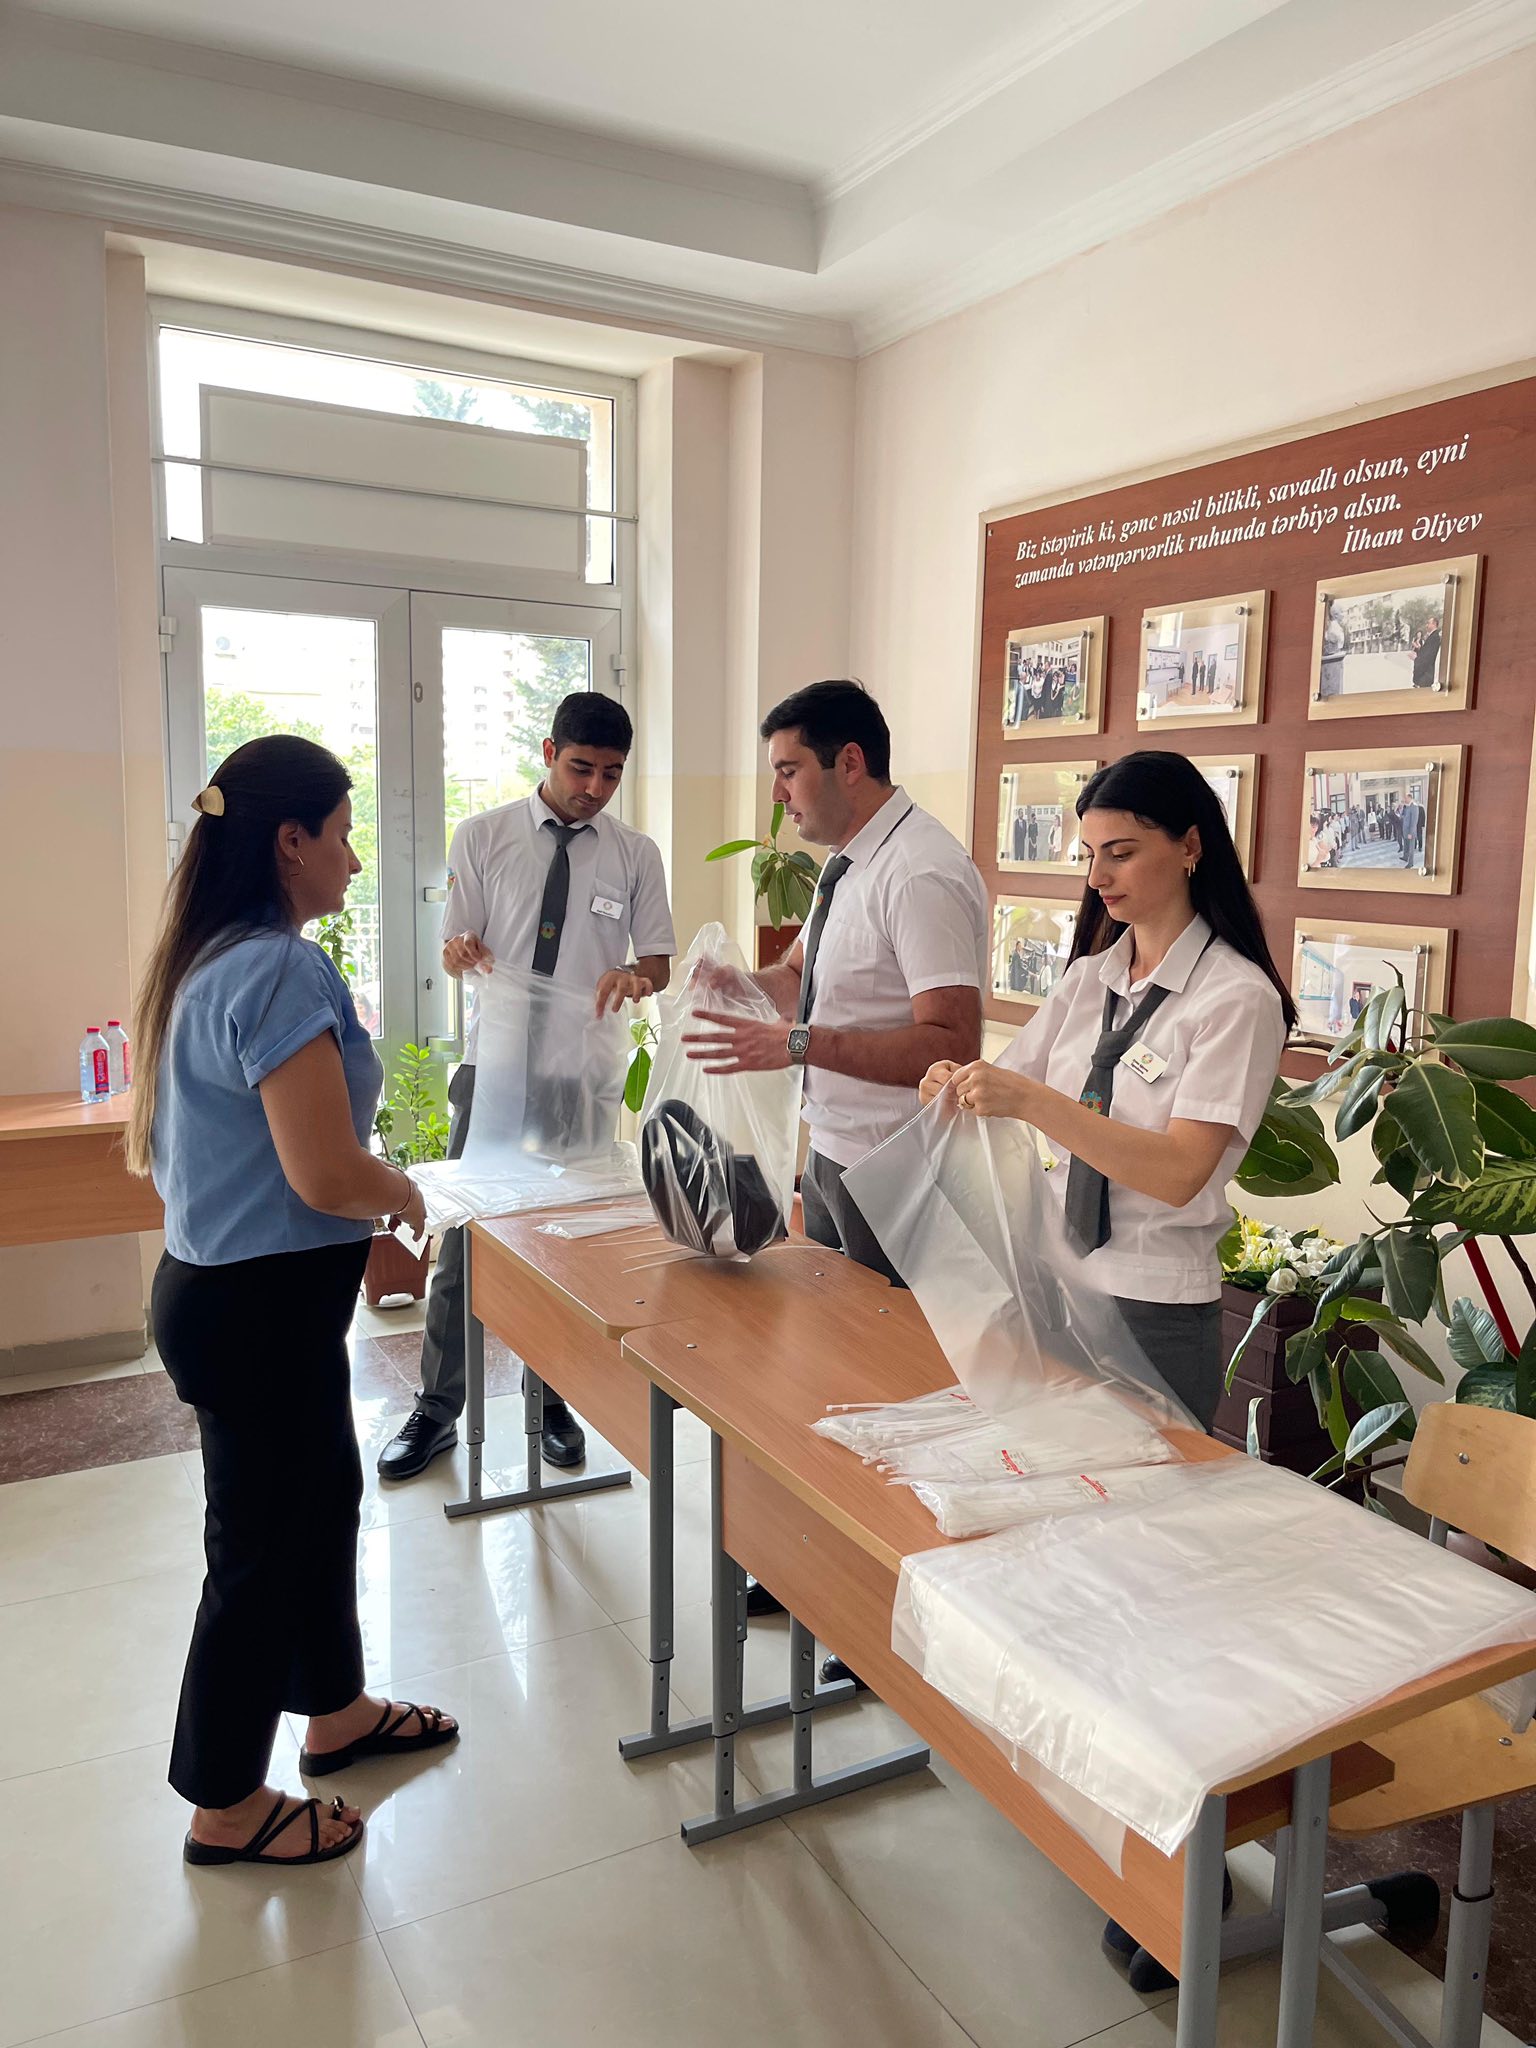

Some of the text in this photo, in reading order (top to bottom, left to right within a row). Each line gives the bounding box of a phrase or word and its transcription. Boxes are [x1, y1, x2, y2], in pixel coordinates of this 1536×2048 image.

[1015, 433, 1470, 561] Biz istəyirik ki, gənc nəsil bilikli, savadlı olsun, eyni
[1015, 492, 1402, 588] zamanda vətənpərvərlik ruhunda tərbiyə alsın.
[1341, 512, 1483, 554] İlham Əliyev
